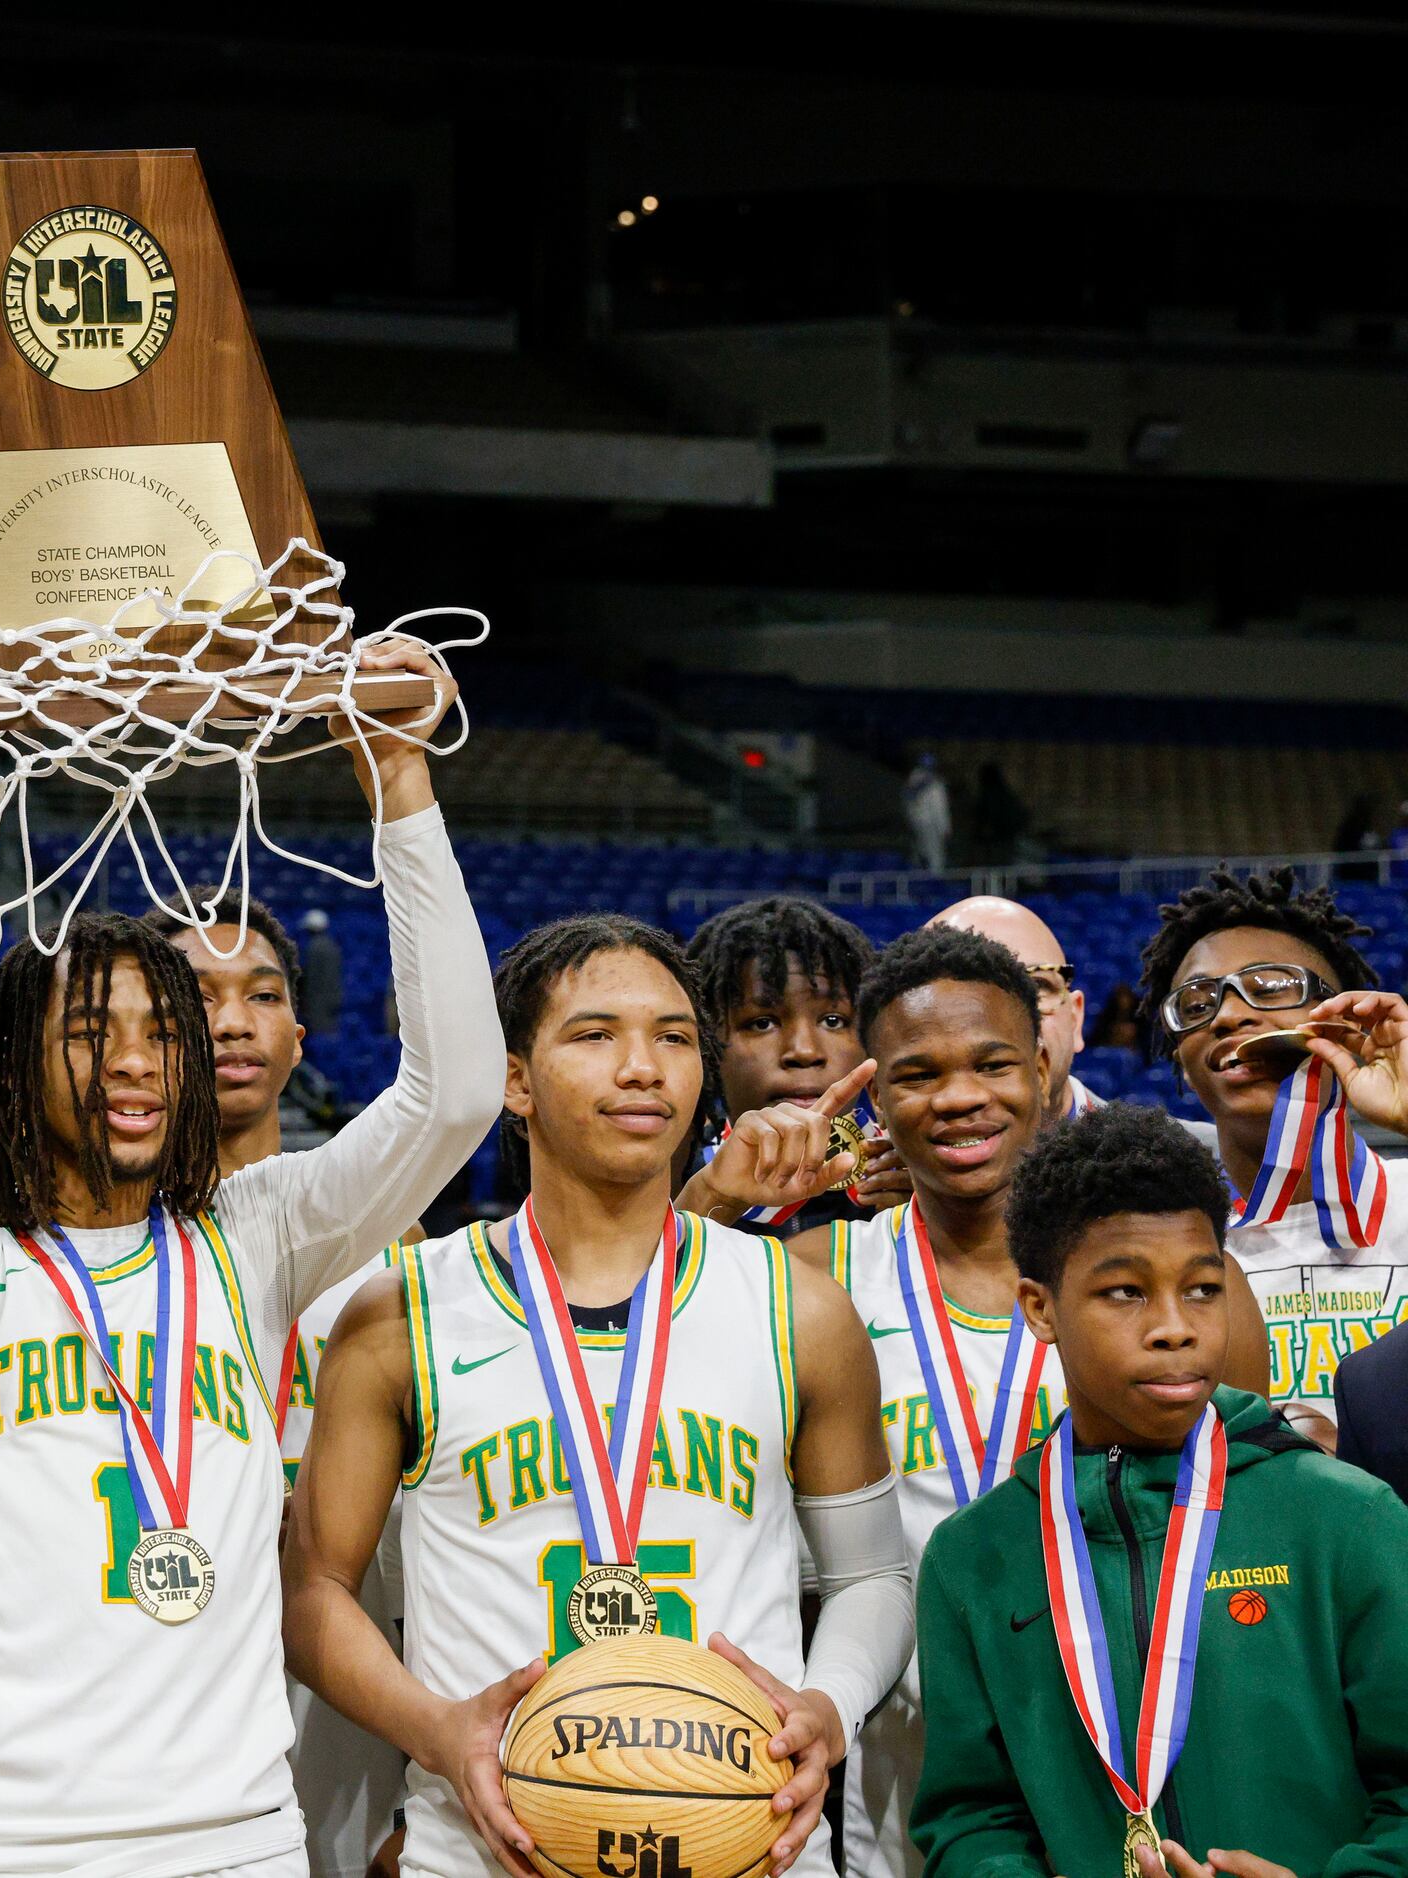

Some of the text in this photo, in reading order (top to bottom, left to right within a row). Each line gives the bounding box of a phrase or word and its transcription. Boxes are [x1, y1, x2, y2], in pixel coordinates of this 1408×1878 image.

[5, 211, 173, 372] UNIVERSITY INTERSCHOLASTIC LEAGUE
[57, 328, 125, 349] STATE
[46, 467, 179, 504] INTERSCHOLASTIC
[175, 498, 222, 550] LEAGUE
[37, 544, 166, 562] STATE CHAMPION
[80, 565, 175, 581] BASKETBALL
[36, 587, 137, 604] CONFERENCE
[1265, 1291, 1383, 1316] JAMES MADISON
[130, 1532, 214, 1615] UNIVERSITY INTERSCHOLASTIC LEAGUE
[1204, 1565, 1290, 1591] MADISON
[157, 1590, 192, 1602] STATE
[579, 1569, 655, 1605] INTERSCHOLASTIC
[537, 1539, 699, 1669] 15
[552, 1714, 751, 1775] SPALDING
